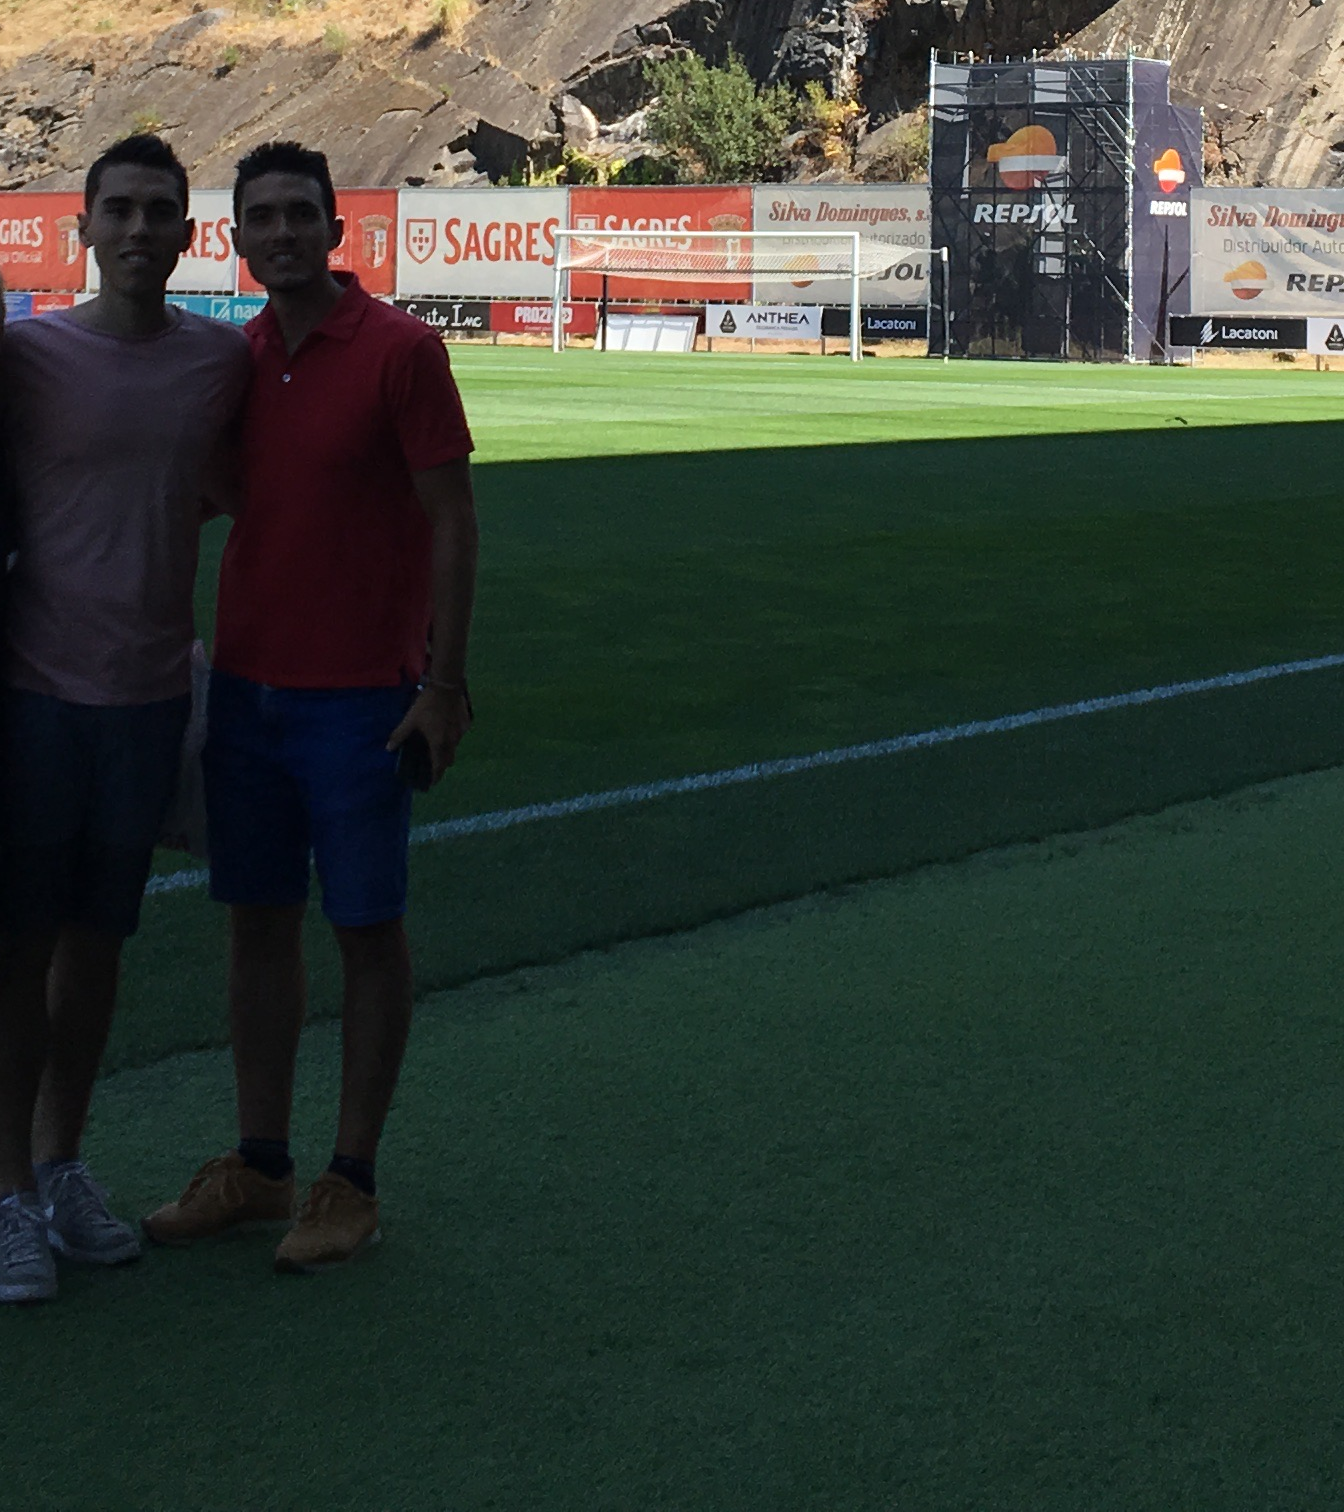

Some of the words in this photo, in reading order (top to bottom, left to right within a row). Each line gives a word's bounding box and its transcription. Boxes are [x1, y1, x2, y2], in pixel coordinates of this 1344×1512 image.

[769, 200, 811, 222] Silva
[815, 201, 912, 226] Domingues,
[973, 204, 1079, 224] REPSOL
[1150, 200, 1188, 217] REPSOL
[1207, 204, 1258, 227] Silva
[181, 217, 231, 262] RES
[443, 217, 560, 266] SAGRES
[861, 232, 926, 246] utorizado
[1223, 239, 1308, 254] Distribuidor
[878, 263, 926, 281] SOL
[452, 304, 483, 328] Inc
[746, 312, 810, 325] ANTHEA
[867, 317, 917, 331] Lacatoni
[1221, 326, 1279, 341] Lacatoni
